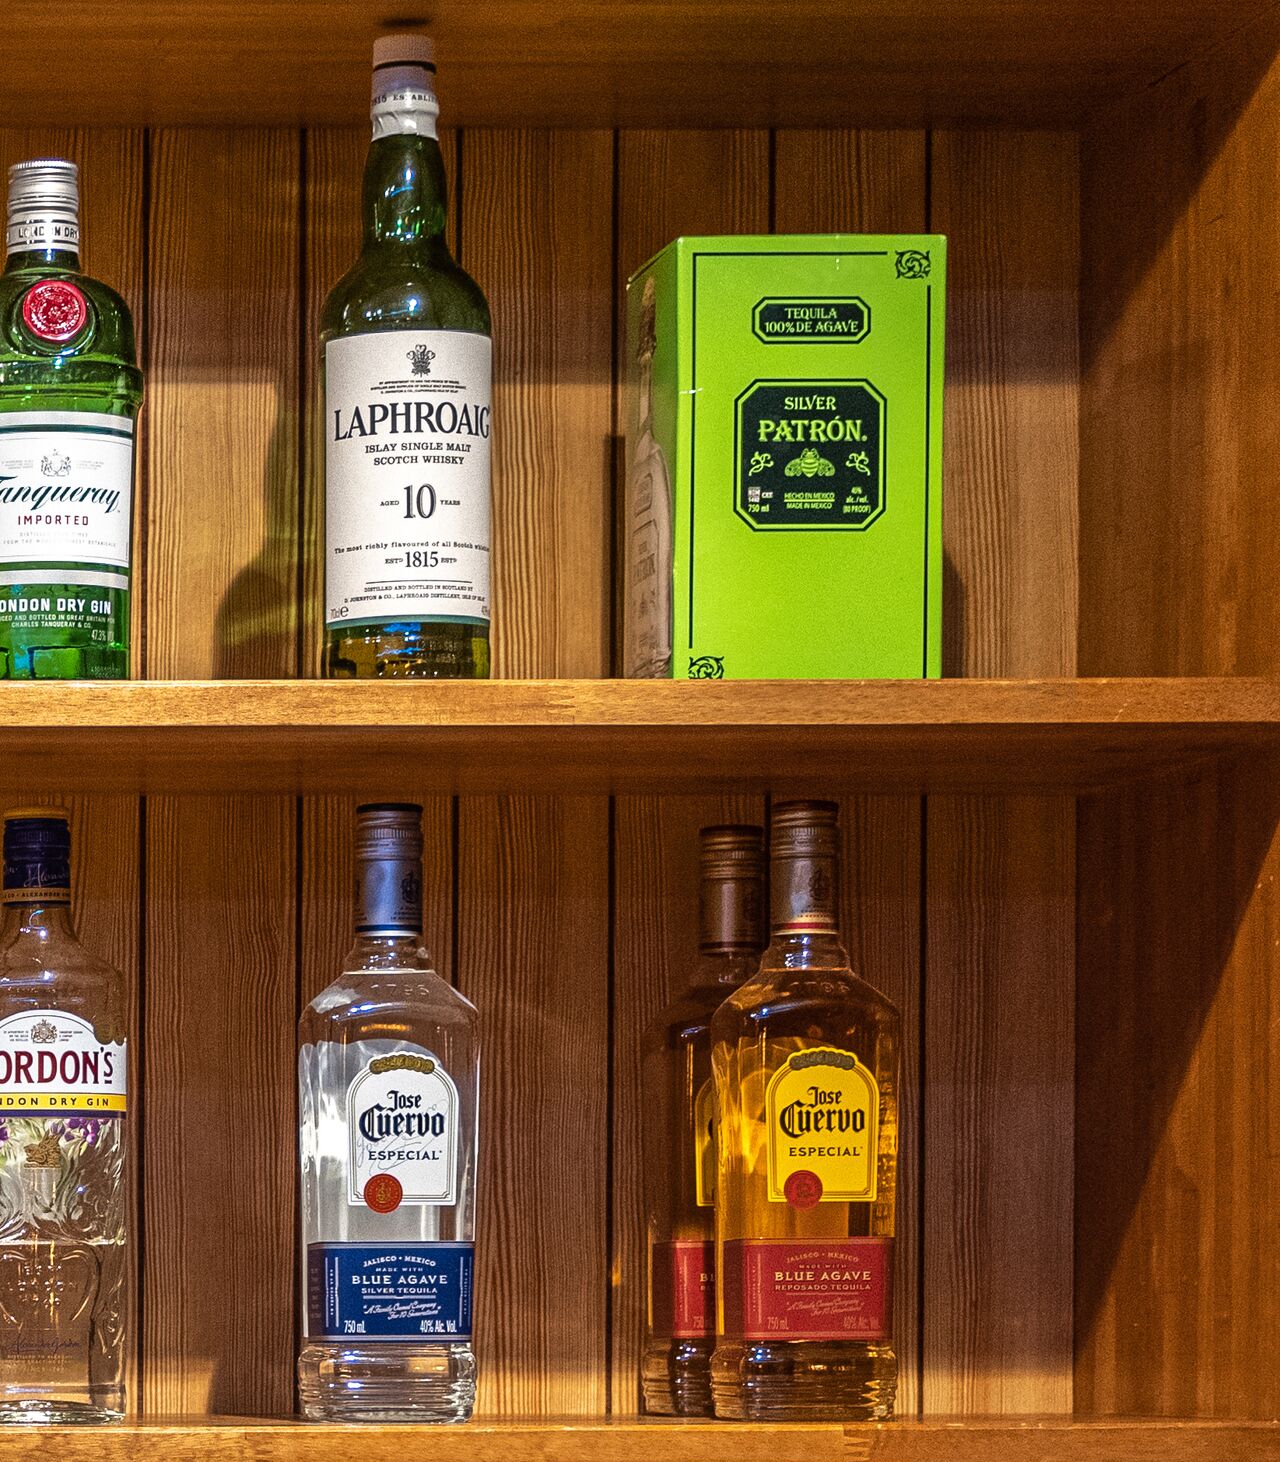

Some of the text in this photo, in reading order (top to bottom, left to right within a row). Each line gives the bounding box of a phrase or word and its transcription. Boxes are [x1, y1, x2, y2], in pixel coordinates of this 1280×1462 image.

[785, 307, 837, 319] TEQUILA
[764, 321, 859, 333] 100% DE AGAVE
[784, 395, 837, 411] SILVER
[334, 402, 489, 441] LAPHROAIG
[365, 443, 471, 453] ISLAY SINGLE MALT
[374, 456, 465, 465] SCOTCH WHISKY
[403, 483, 436, 519] 10
[18, 515, 89, 526] IMPORTED
[57, 598, 84, 612] DRY
[90, 601, 111, 614] GIN
[49, 1097, 77, 1106] DRY
[87, 1098, 109, 1106] GIN
[387, 1089, 422, 1111] Jose
[807, 1086, 842, 1109] Jose
[358, 1104, 445, 1143] Cuervo
[779, 1099, 865, 1139] Cuervo
[368, 1150, 439, 1161] ESPECIAL
[789, 1146, 860, 1157] ESPECIAL
[352, 1275, 448, 1285] BLUE AGAVE
[774, 1271, 872, 1281] BLUE AGAVE
